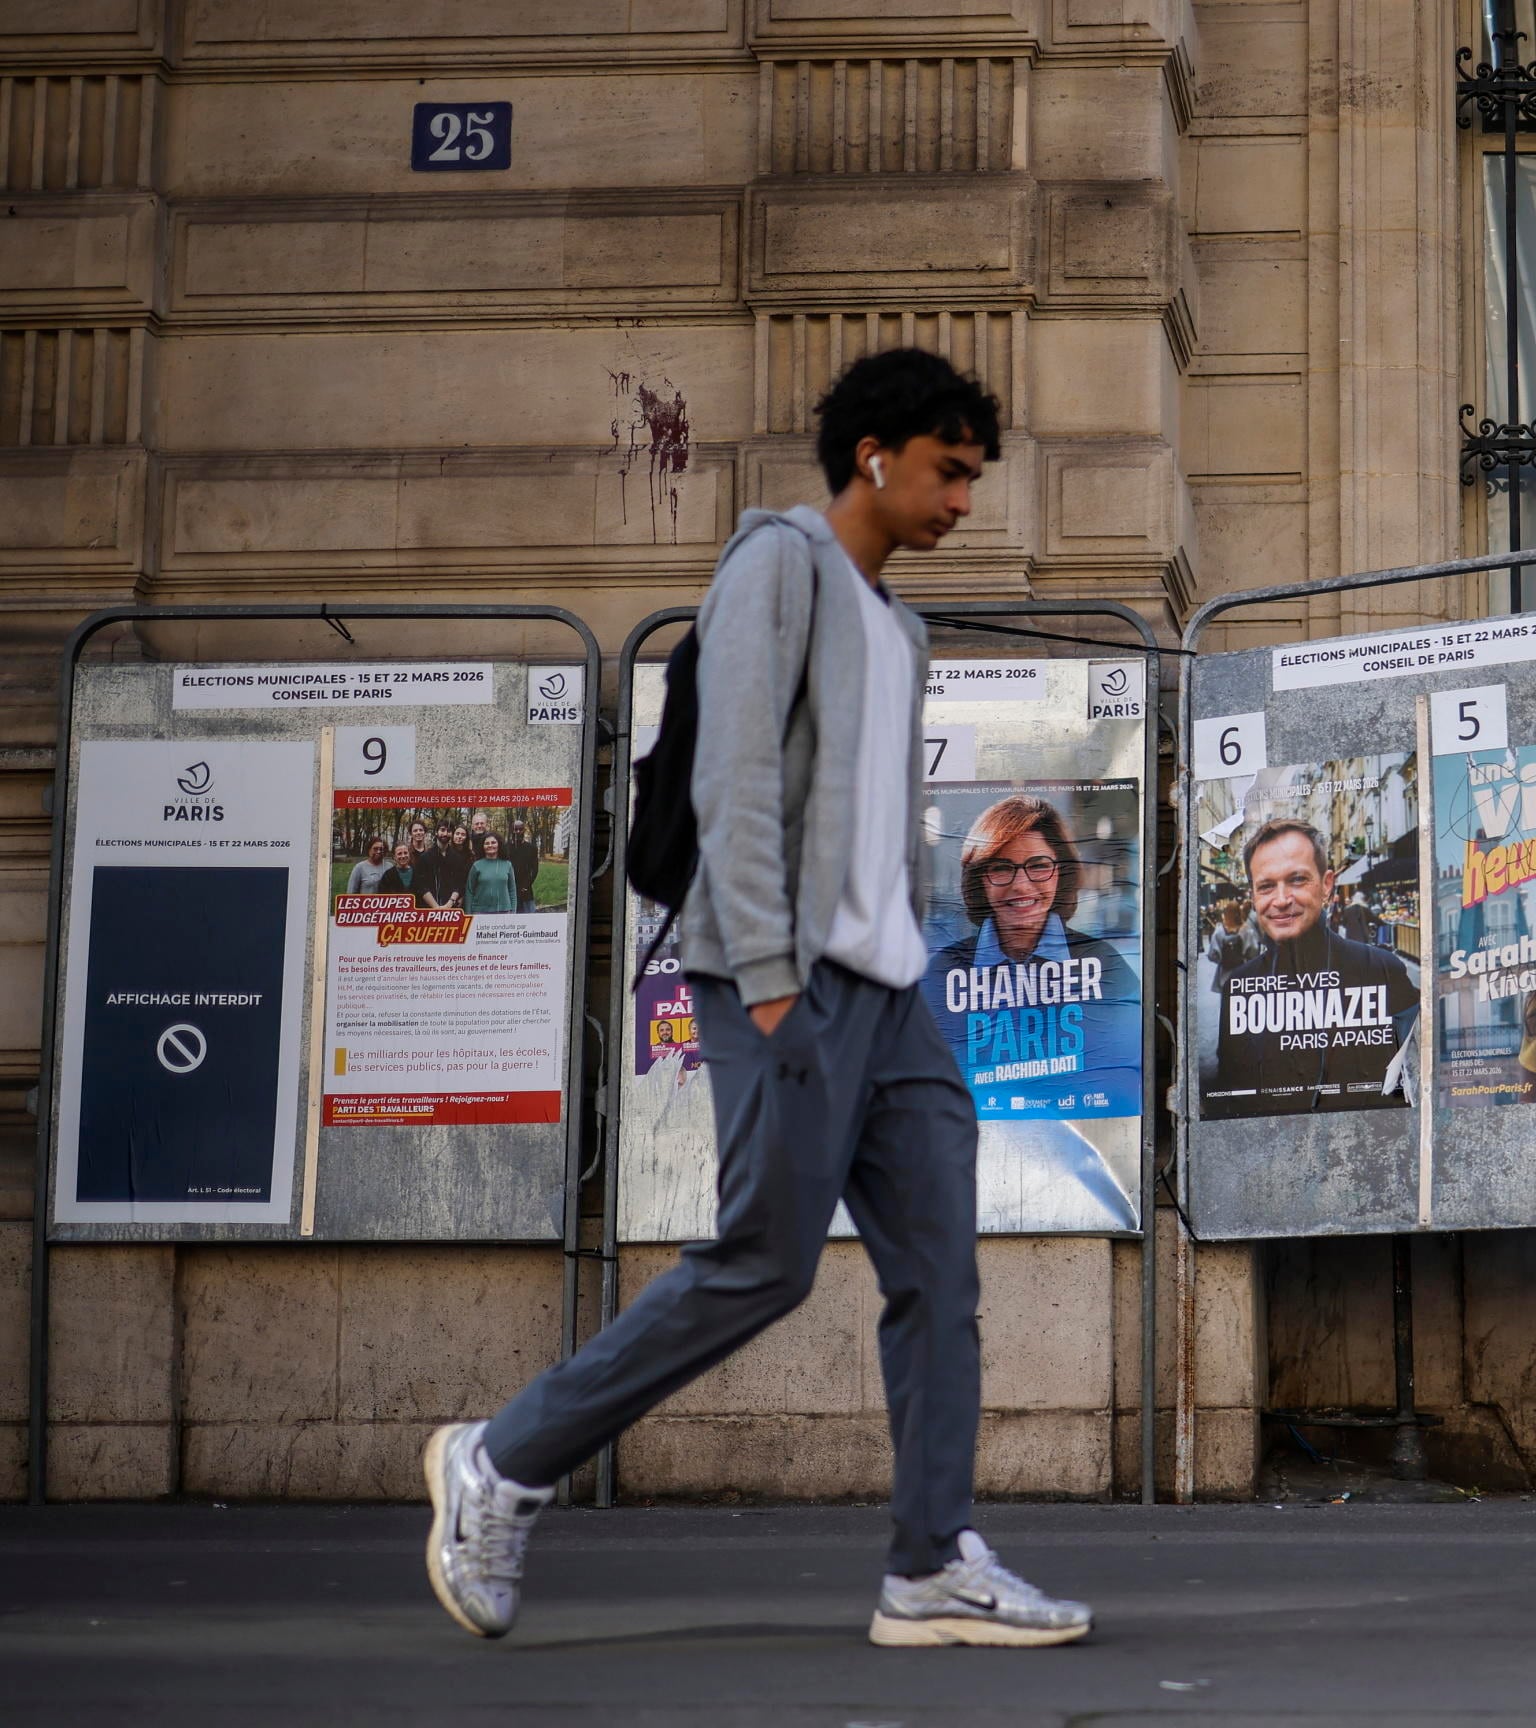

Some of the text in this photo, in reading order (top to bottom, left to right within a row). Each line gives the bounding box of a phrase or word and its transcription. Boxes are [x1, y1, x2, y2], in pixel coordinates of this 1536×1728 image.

[428, 112, 495, 161] 25
[1280, 649, 1345, 666] ÉLECTIONS
[1348, 638, 1430, 657] MUNICIPALES
[1441, 635, 1453, 645] 15
[1457, 633, 1471, 644] ET
[1474, 631, 1488, 641] 22
[1492, 626, 1528, 639] MARS
[1363, 649, 1474, 671] CONSEIL DE PARIS
[182, 671, 483, 686] ÉLECTIONS MUNICIPALES 15 ET 22 MARS 2026
[928, 669, 1036, 679] ET 22 MARS 2026
[272, 688, 392, 700] CONSEIL DE PARIS
[529, 707, 578, 721] PARIS
[1093, 703, 1140, 718] PARIS
[1458, 700, 1481, 741] 5
[362, 737, 387, 775] 9
[924, 738, 948, 776] 7
[1219, 726, 1242, 766] 6
[163, 805, 224, 821] PARIS
[336, 897, 411, 909] LES COUPES
[338, 910, 461, 924] BUDGÉTAIRES PARIS
[381, 924, 458, 947] ÇA SUFFIT
[499, 930, 558, 938] Pierot-Guimbaud
[946, 957, 1103, 1012] CHANGER
[1230, 971, 1340, 994] PIERRE-YVES
[106, 993, 262, 1005] AFFICHAGE INTERDIT
[1229, 984, 1393, 1035] BOURNAZEL
[967, 1004, 1084, 1064] PARIS
[1280, 1025, 1393, 1051] PARIS APAISÉ
[348, 1047, 549, 1060] Les milliards pour les hôpitaux, les écoles,
[974, 1055, 1077, 1085] AVEC RACHIDA DATI
[1451, 1082, 1533, 1097] SarahPourParis.fr
